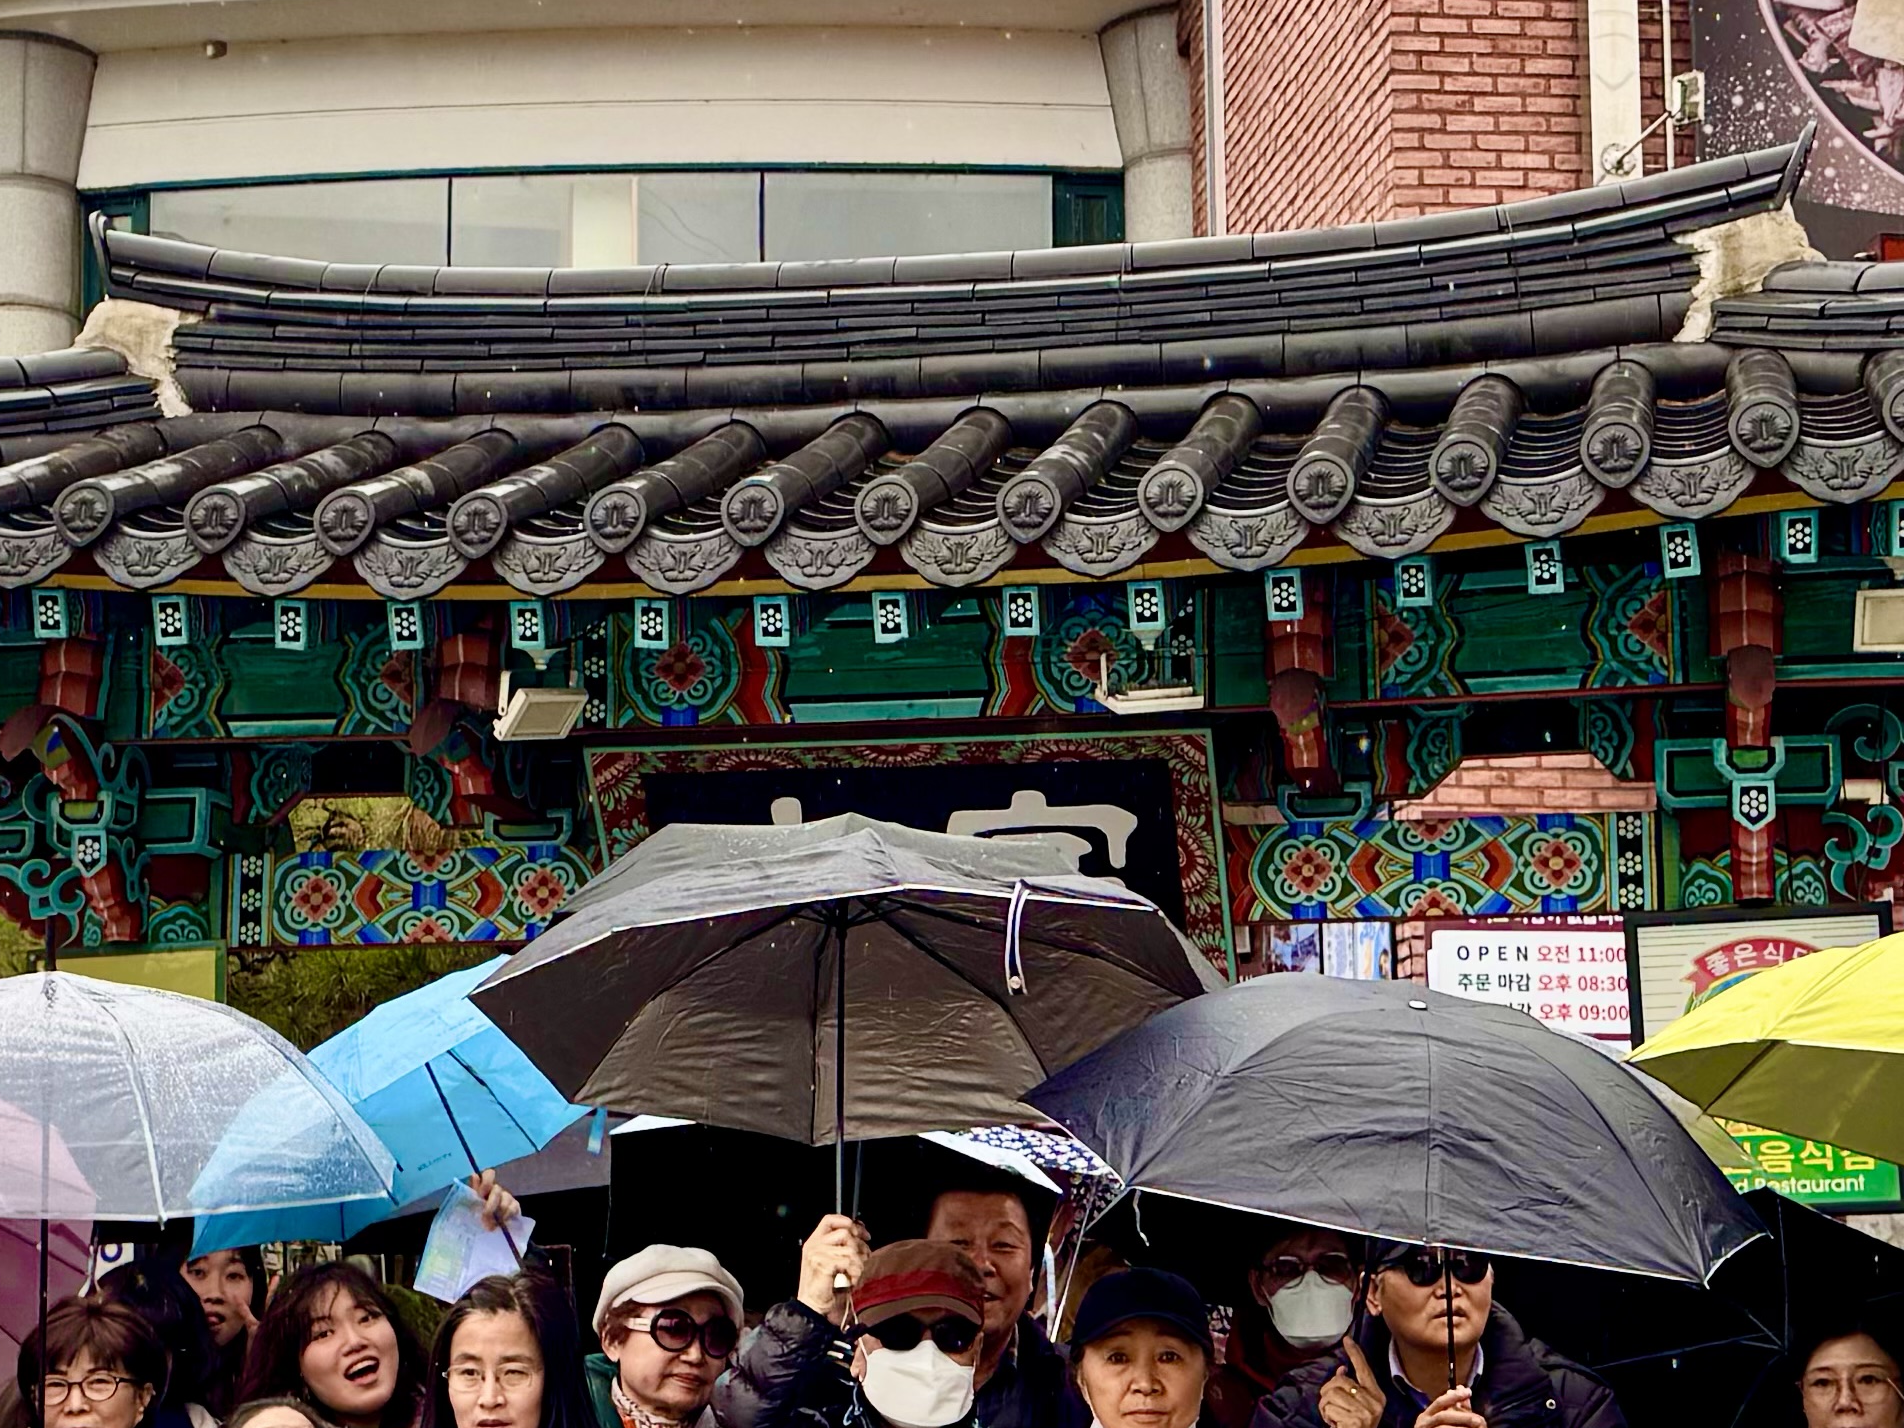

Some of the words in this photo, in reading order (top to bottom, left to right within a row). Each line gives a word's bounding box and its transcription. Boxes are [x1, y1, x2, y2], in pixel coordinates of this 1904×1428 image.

[1456, 945, 1529, 962] OPEN
[1538, 944, 1569, 963] 오전
[1578, 946, 1626, 963] 11:00
[1458, 973, 1492, 992] 주문
[1498, 973, 1531, 992] 마감
[1538, 973, 1572, 993] 오후
[1578, 974, 1628, 992] 08:30
[1539, 1003, 1572, 1022] 오후
[1579, 1004, 1629, 1021] 09:00
